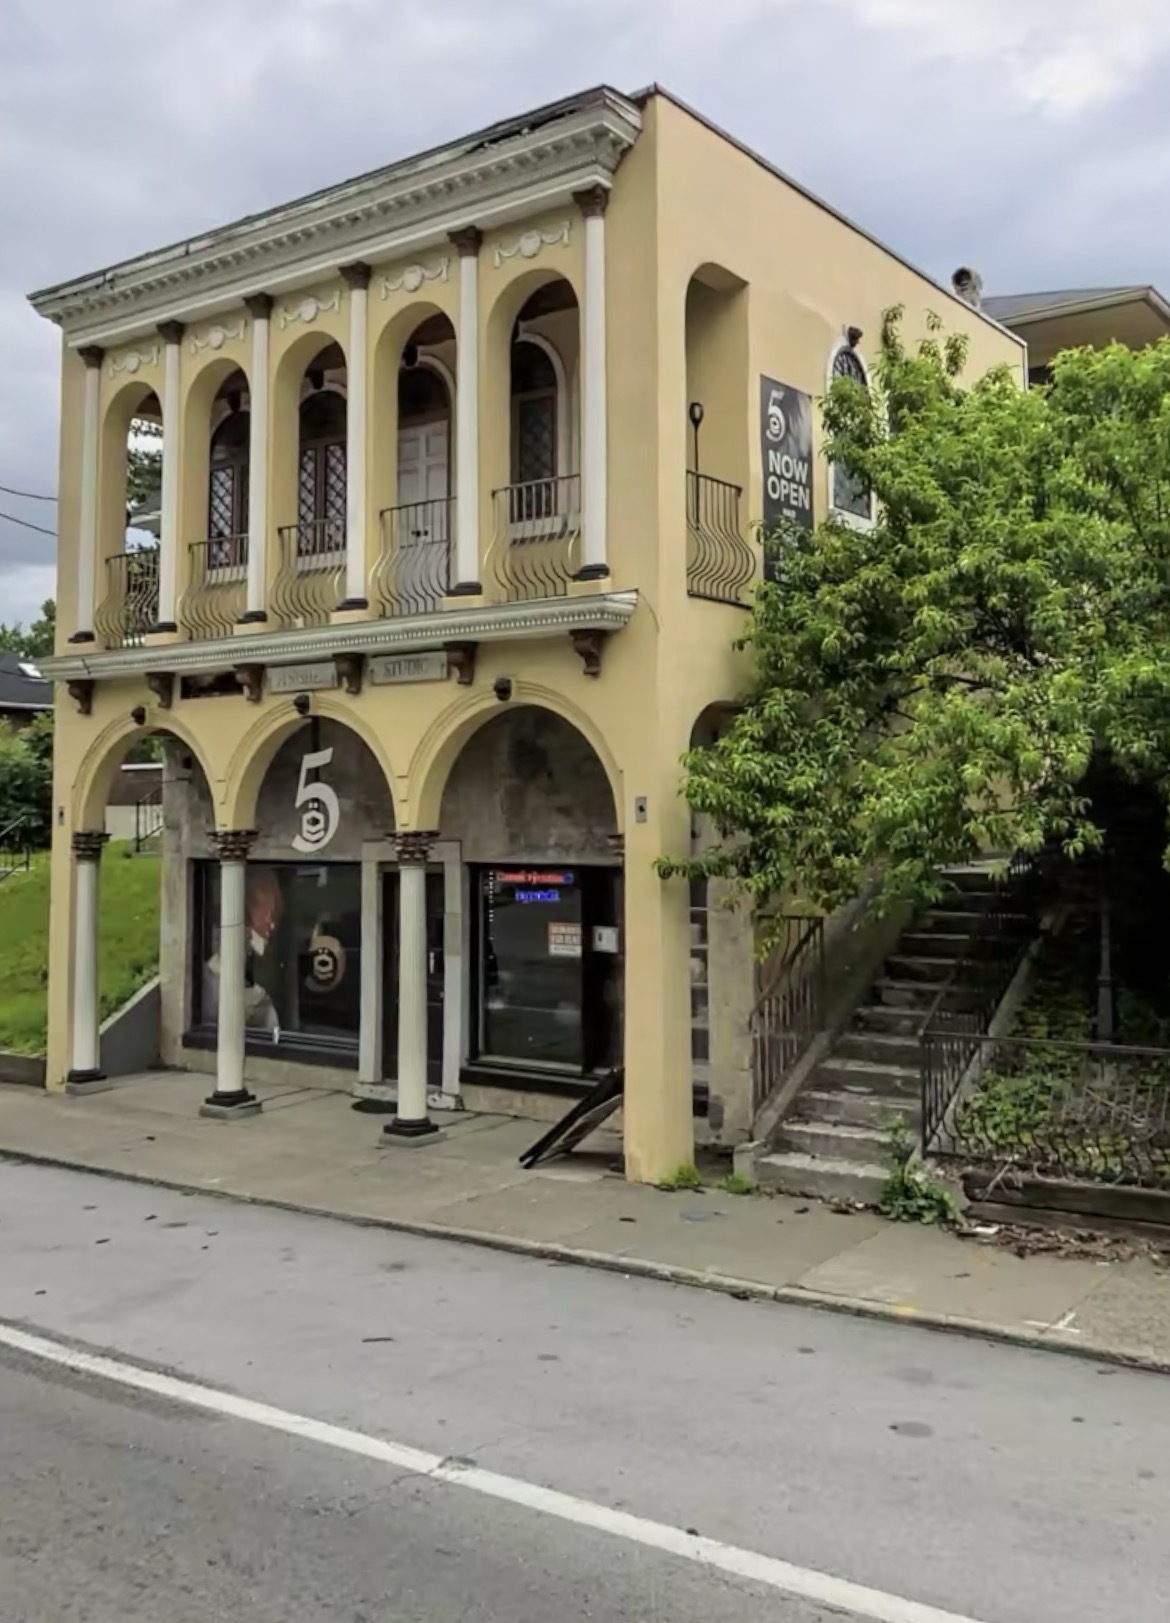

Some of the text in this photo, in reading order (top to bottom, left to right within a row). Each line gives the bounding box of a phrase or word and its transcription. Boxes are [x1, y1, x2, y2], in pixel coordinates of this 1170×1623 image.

[769, 449, 808, 484] NOW
[767, 478, 810, 511] OPEN
[291, 747, 340, 852] 5
